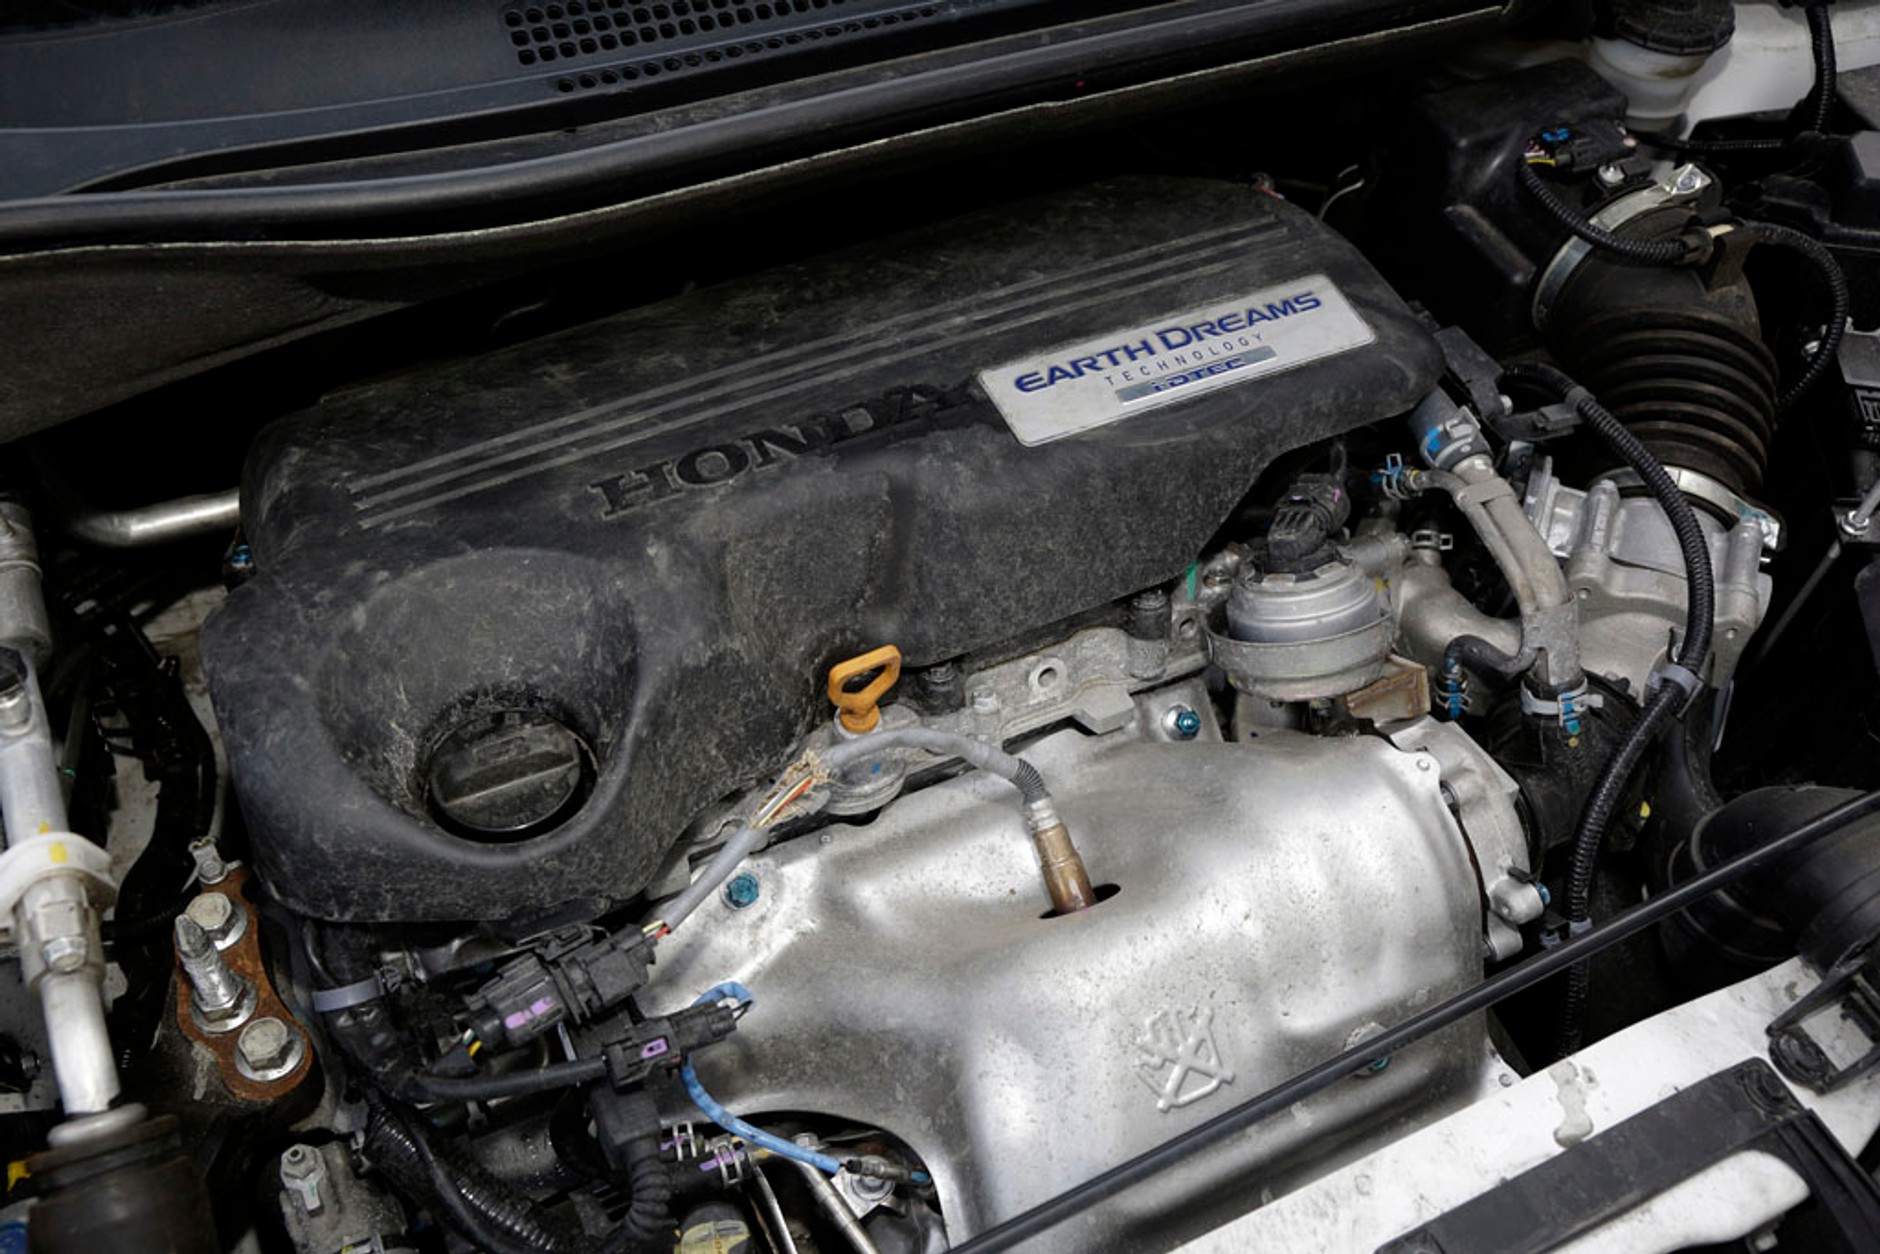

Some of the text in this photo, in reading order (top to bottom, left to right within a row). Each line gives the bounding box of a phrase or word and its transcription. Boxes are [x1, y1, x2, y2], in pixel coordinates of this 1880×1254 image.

[1014, 291, 1322, 393] EARTH DREAMS
[1105, 332, 1264, 387] TECHNOLOGY
[587, 382, 952, 519] HONDA
